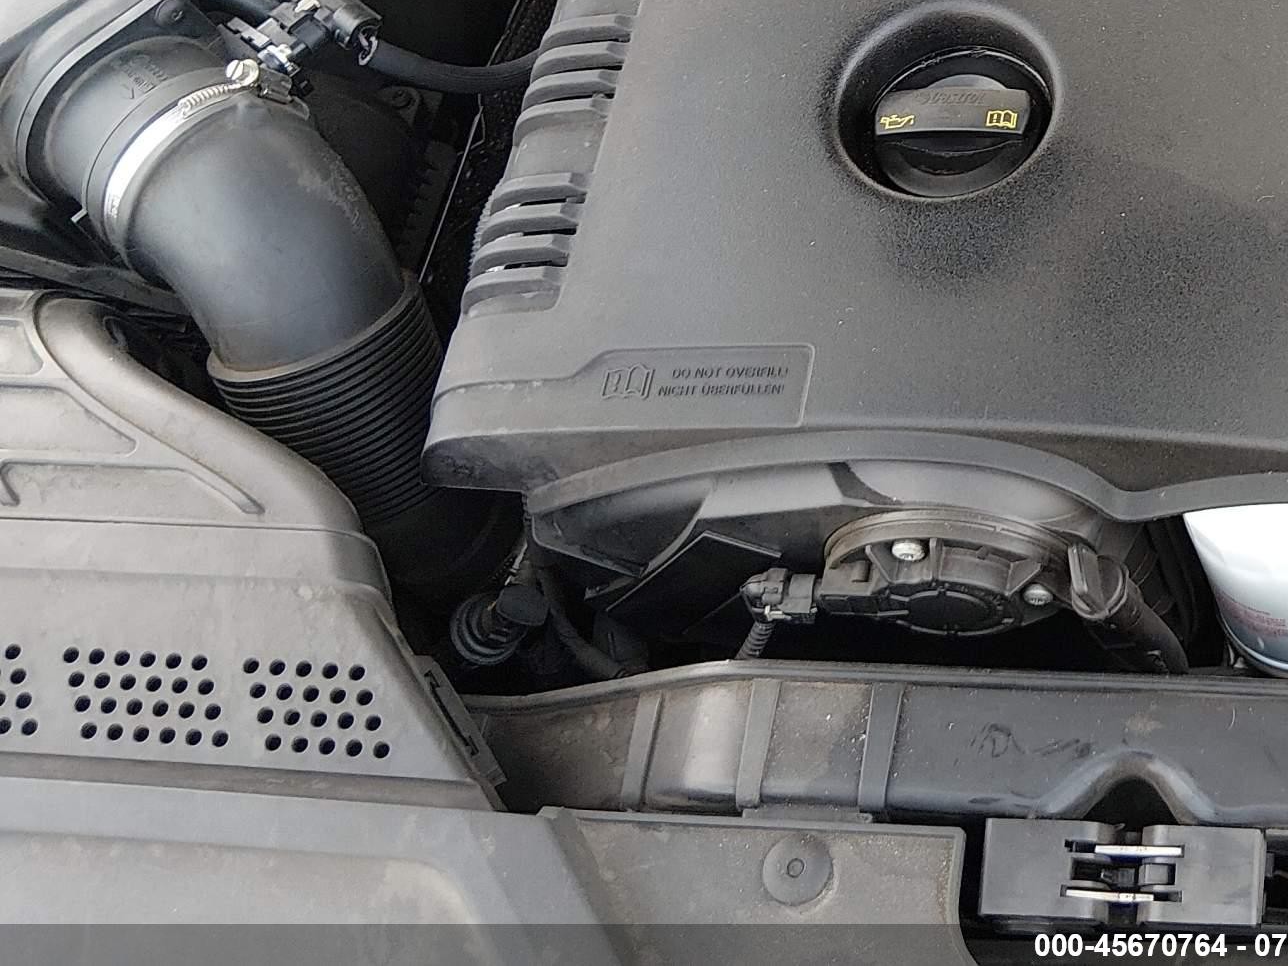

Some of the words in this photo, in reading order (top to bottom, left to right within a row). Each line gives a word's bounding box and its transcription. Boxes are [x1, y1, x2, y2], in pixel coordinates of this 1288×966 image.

[672, 368, 691, 379] DO
[694, 367, 722, 379] NOT
[725, 366, 789, 379] OVERFILL!
[658, 385, 696, 397] NICHT
